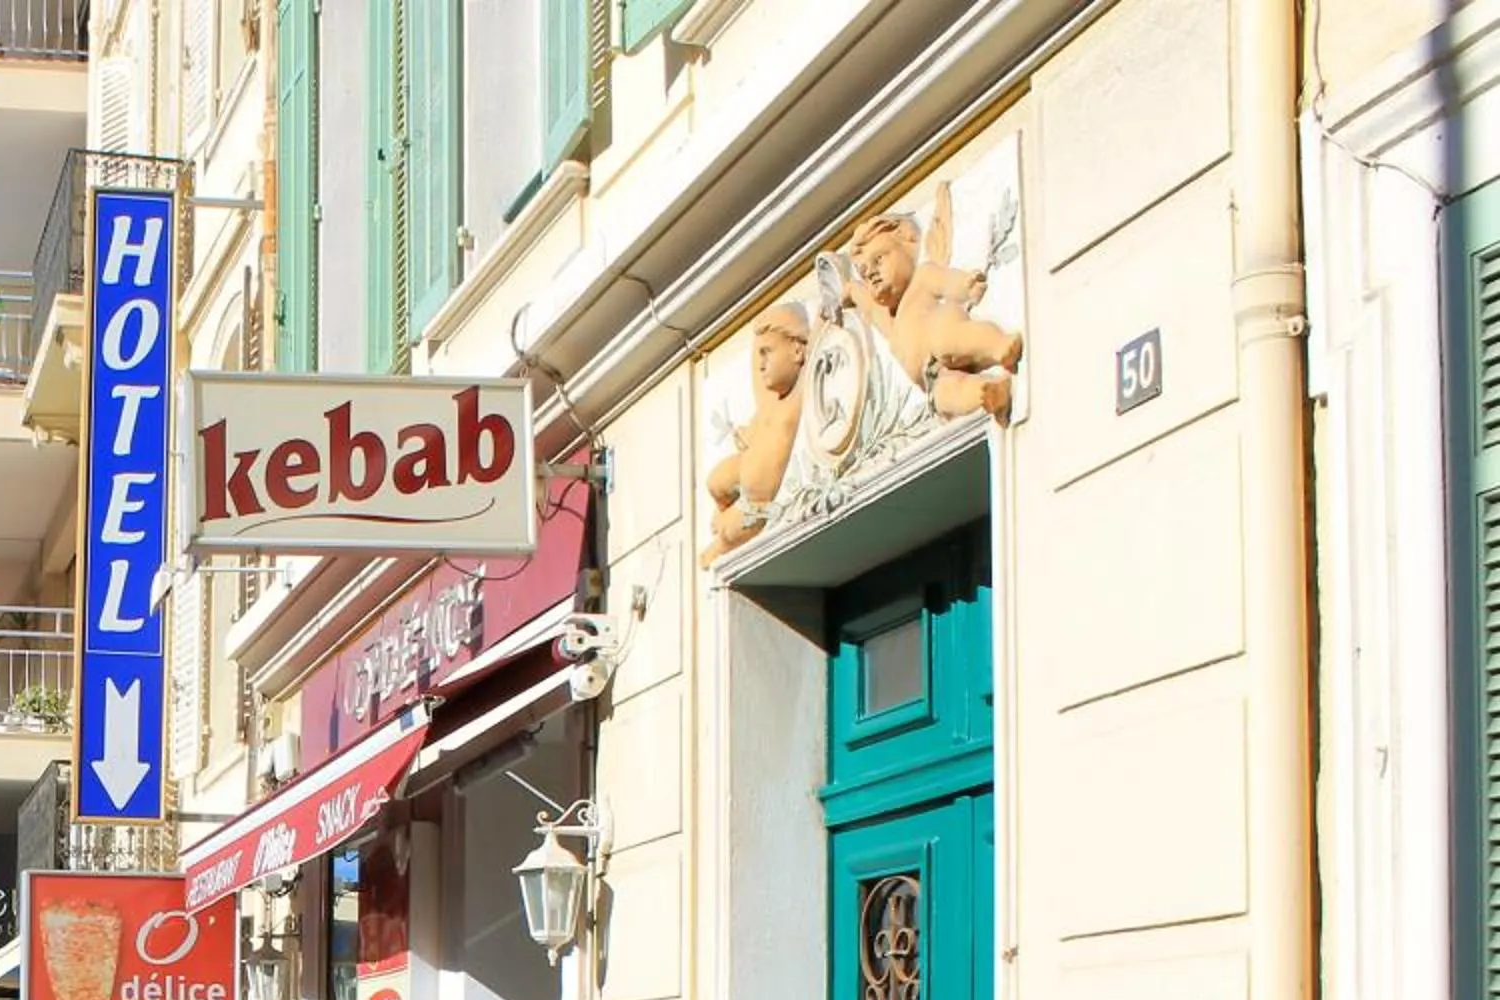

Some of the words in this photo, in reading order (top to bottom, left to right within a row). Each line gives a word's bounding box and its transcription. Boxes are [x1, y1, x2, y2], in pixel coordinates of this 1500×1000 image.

[99, 215, 164, 633] HOTEL
[1122, 341, 1155, 399] 50
[198, 384, 515, 522] kebab
